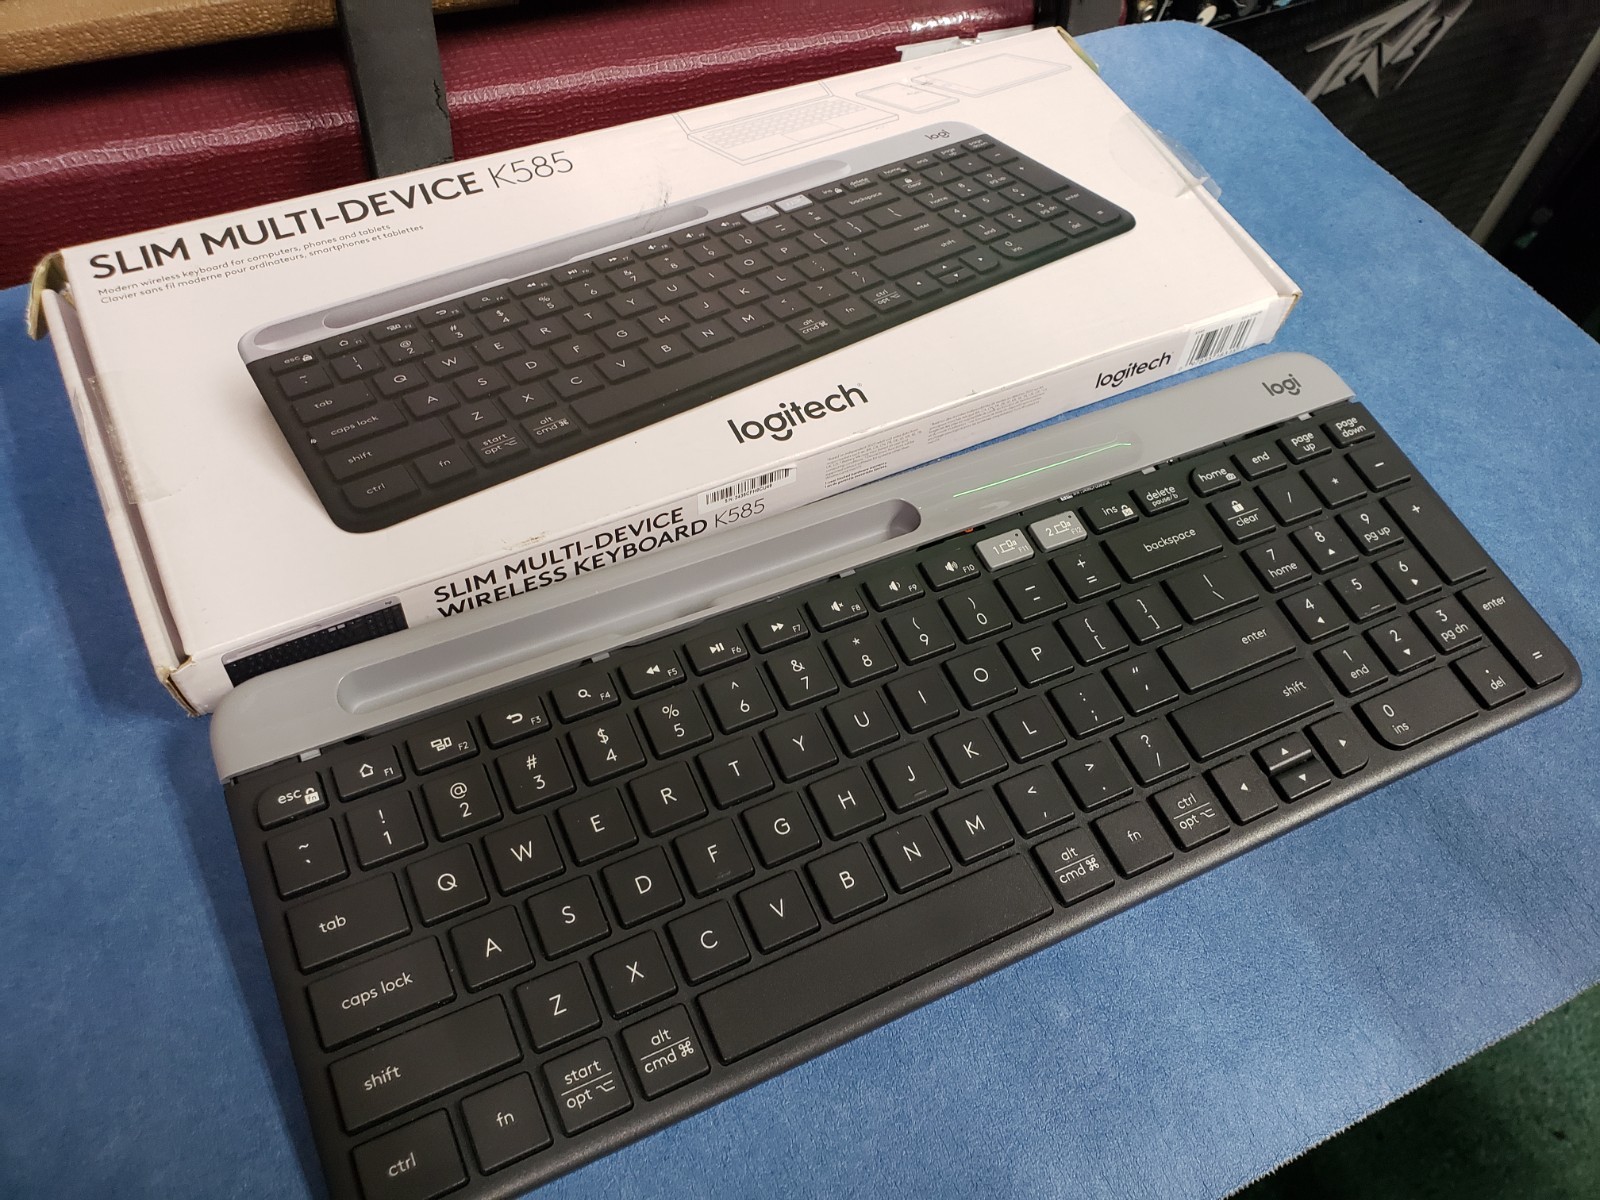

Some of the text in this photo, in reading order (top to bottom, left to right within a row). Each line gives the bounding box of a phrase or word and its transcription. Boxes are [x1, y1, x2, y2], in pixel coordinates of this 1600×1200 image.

[925, 128, 950, 141] logi
[89, 150, 573, 279] SLIM MULTI-DEVICE K585
[98, 224, 391, 297] Modern wireless keyboard for computers, phones and tablets
[100, 224, 424, 304] Clavier sans fil moderne pour ordinateurs, smartphones et tablettes
[539, 327, 552, 335] R
[493, 342, 504, 350] E
[283, 355, 299, 364] esc
[441, 356, 457, 367] W
[1095, 352, 1171, 388] logitech
[393, 374, 408, 383] Q
[477, 377, 488, 386] S
[570, 376, 583, 385] C
[1261, 373, 1302, 397] logi
[314, 399, 333, 409] tab
[427, 395, 439, 404] A
[522, 393, 534, 403] X
[471, 411, 484, 421] Z
[539, 416, 554, 426] alt
[727, 383, 869, 444] logitech
[330, 414, 380, 437] caps lock
[536, 423, 558, 436] cmd
[1335, 415, 1359, 431] page
[1341, 424, 1367, 438] down
[482, 433, 508, 446] start
[1291, 431, 1314, 447] page
[484, 445, 503, 455] opt
[1303, 442, 1316, 453] up
[348, 451, 371, 463] shift
[1251, 451, 1270, 464] end
[1198, 466, 1227, 482] home
[366, 482, 386, 495] ctrl
[1145, 484, 1176, 502] delete
[1101, 506, 1118, 516] ins
[1235, 513, 1260, 528] clear
[1360, 513, 1370, 525] 9
[1044, 527, 1054, 538] 2
[1071, 525, 1084, 536] F12
[1314, 531, 1326, 543] 8
[1364, 525, 1391, 543] pg up
[1143, 529, 1197, 553] backspace
[434, 506, 684, 602] SLIM MULTI-DEVICE
[437, 498, 765, 618] WIRELESS KEYBOARD K585
[992, 546, 1000, 556] 1
[1265, 548, 1275, 561] 7
[962, 563, 975, 574] F10
[1267, 560, 1299, 578] home
[1398, 560, 1409, 572] 6
[908, 583, 917, 592] F9
[1350, 578, 1363, 591] 5
[850, 604, 861, 612] F8
[1305, 598, 1315, 610] 4
[1482, 596, 1506, 611] enter
[976, 612, 988, 625] 0
[1435, 609, 1448, 622] 3
[792, 623, 801, 633] F7
[1389, 629, 1402, 642] 2
[1441, 621, 1469, 643] pg dn
[919, 633, 929, 646] 9
[1241, 628, 1267, 645] enter
[731, 645, 742, 655] F6
[1030, 646, 1042, 662] P
[1342, 649, 1353, 661] 1
[861, 654, 873, 667] 8
[667, 667, 678, 677] F5
[973, 667, 989, 683] O
[1350, 663, 1370, 679] end
[800, 675, 809, 690] 7
[1282, 680, 1307, 697] shift
[1490, 675, 1506, 690] del
[599, 691, 611, 701] F4
[917, 690, 927, 704] I
[740, 699, 750, 713] 6
[1382, 704, 1395, 718] 0
[530, 715, 542, 725] F3
[853, 711, 870, 728] U
[673, 722, 685, 737] 5
[1022, 720, 1037, 735] L
[1391, 722, 1410, 734] ins
[457, 741, 469, 751] F2
[792, 735, 805, 752] Y
[962, 741, 980, 759] K
[606, 748, 618, 762] 4
[383, 767, 394, 777] F1
[728, 760, 740, 777] T
[907, 765, 916, 782] J
[533, 774, 546, 790] 3
[277, 788, 303, 805] esc
[660, 787, 678, 805] R
[837, 790, 856, 810] H
[1176, 793, 1198, 810] ctrl
[459, 802, 472, 818] 2
[590, 814, 605, 833] E
[773, 817, 791, 835] G
[965, 814, 986, 835] M
[1179, 815, 1199, 830] opt
[383, 830, 392, 845] 1
[1127, 830, 1142, 842] fn
[510, 840, 532, 862] W
[707, 844, 718, 863] F
[902, 841, 922, 862] N
[1060, 847, 1078, 862] alt
[838, 870, 855, 890] B
[1058, 864, 1087, 884] cmd
[437, 873, 458, 892] Q
[634, 875, 652, 895] D
[561, 905, 576, 924] S
[769, 898, 784, 918] V
[318, 914, 347, 933] tab
[700, 930, 718, 949] C
[486, 937, 503, 958] A
[625, 961, 645, 983] X
[341, 972, 414, 1012] caps lock
[548, 993, 567, 1016] Z
[650, 1028, 672, 1047] alt
[644, 1049, 678, 1074] cmd
[364, 1065, 401, 1091] shift
[564, 1059, 602, 1084] start
[566, 1089, 593, 1109] opt
[496, 1111, 515, 1128] fn
[388, 1151, 417, 1177] ctrl
